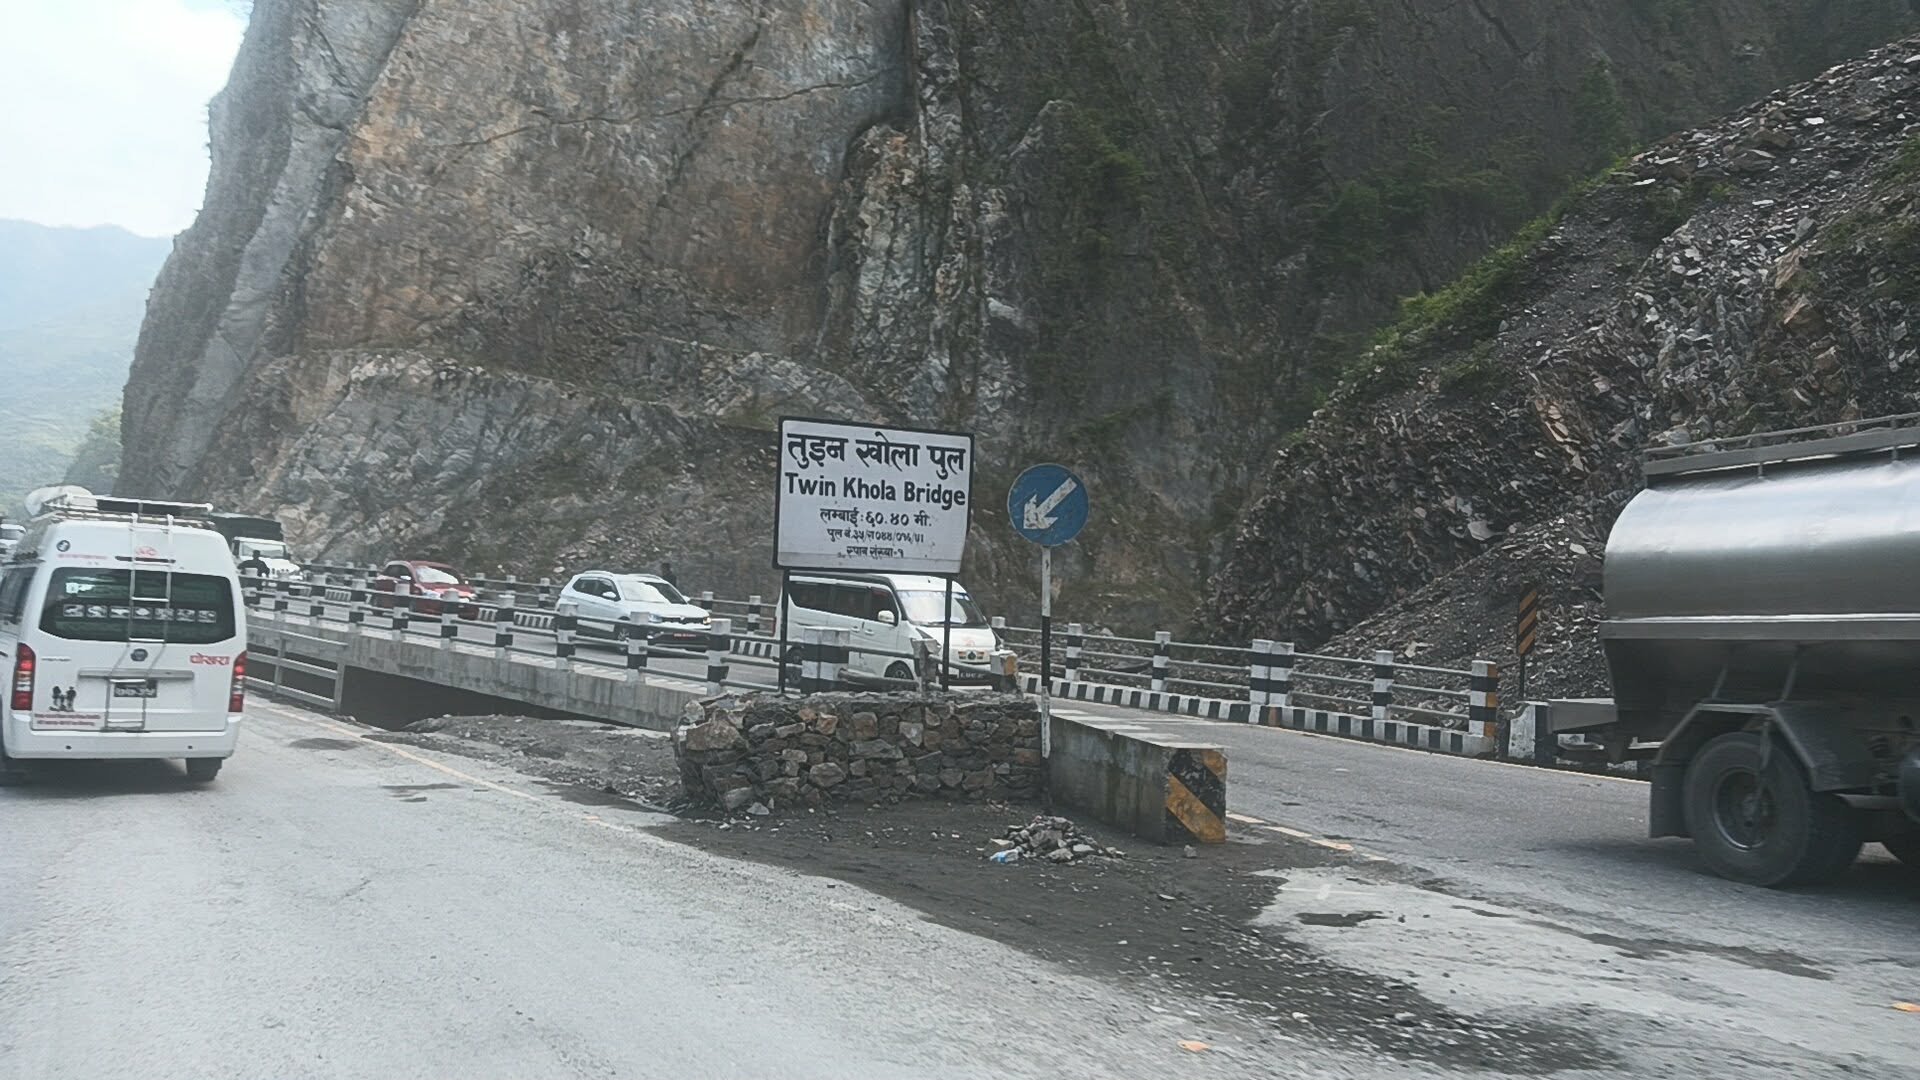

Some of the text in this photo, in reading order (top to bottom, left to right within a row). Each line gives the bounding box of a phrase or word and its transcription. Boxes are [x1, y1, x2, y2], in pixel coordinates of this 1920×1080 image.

[855, 431, 920, 472] खोला
[926, 445, 966, 480] पुल
[785, 472, 966, 510] Twin Khola Bridge
